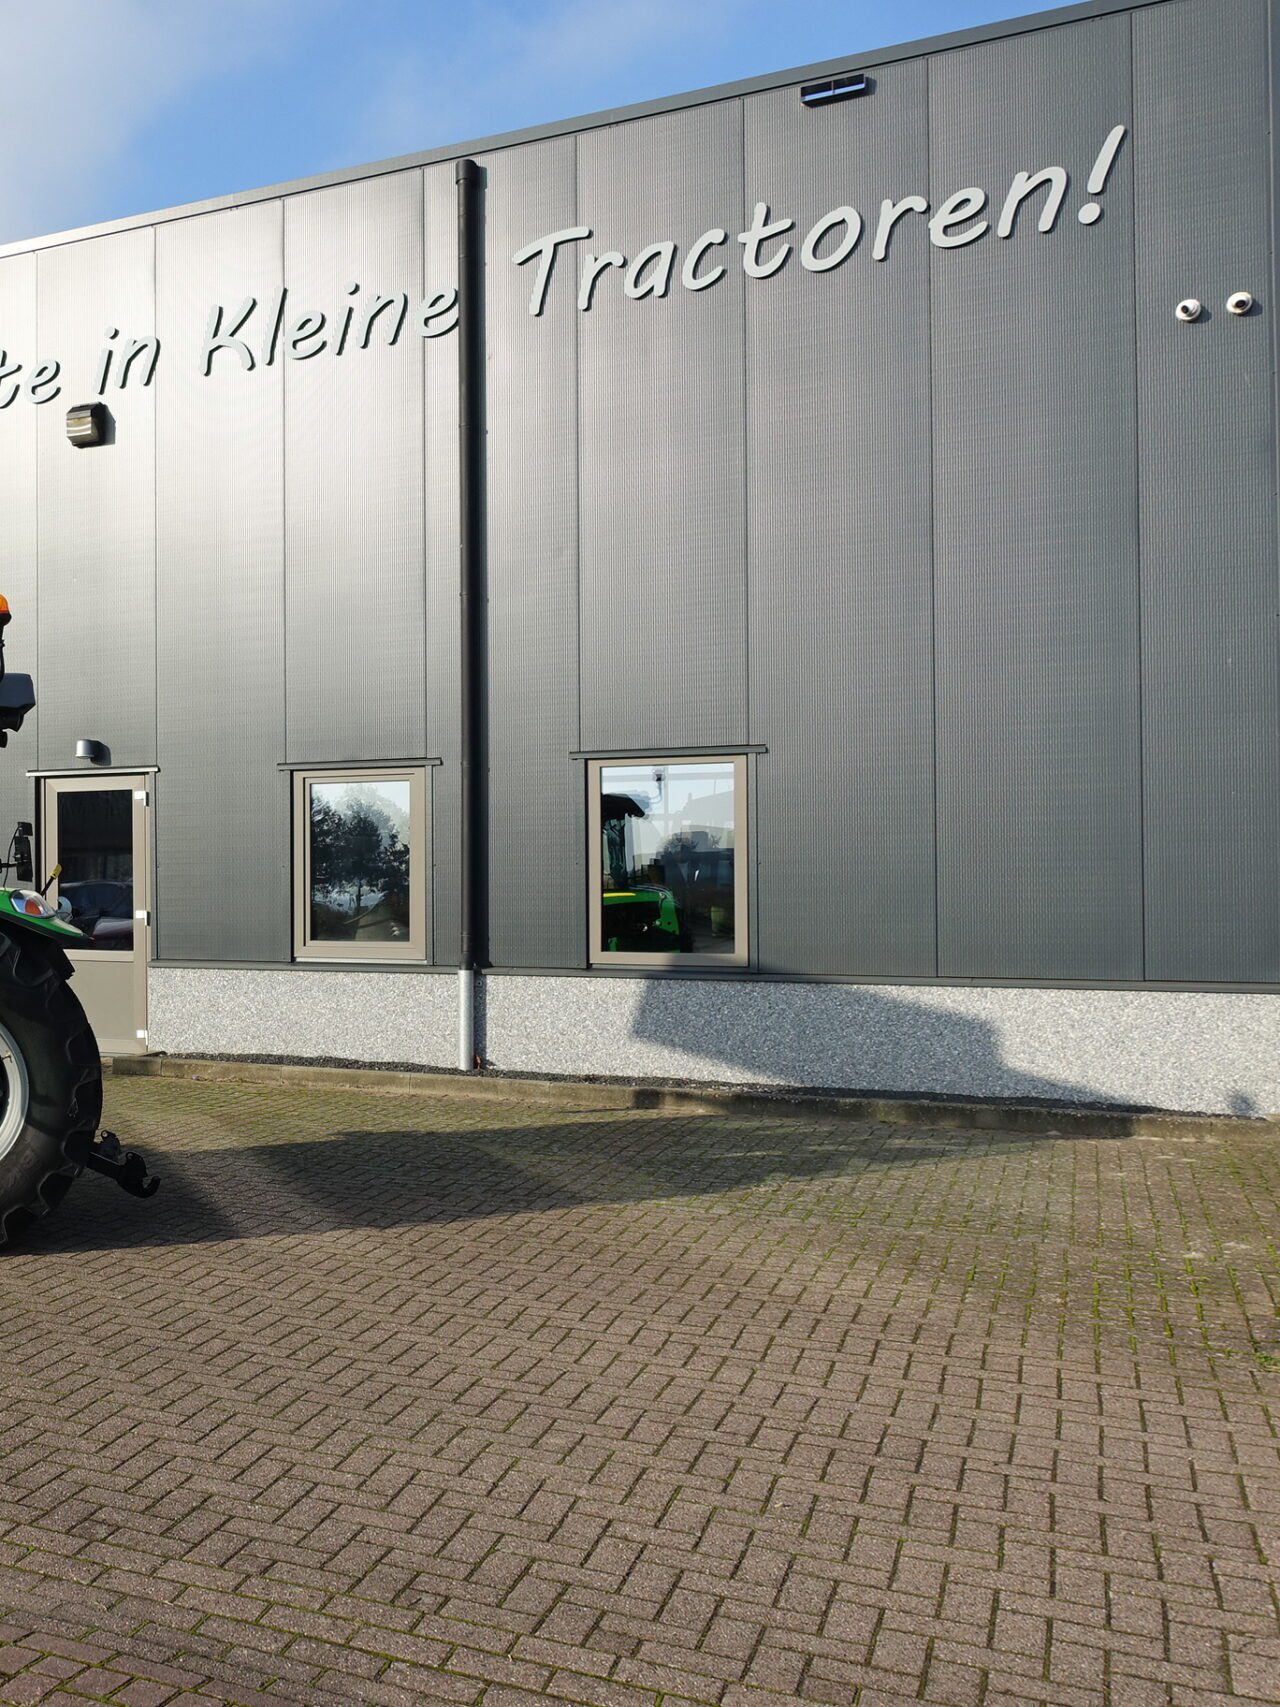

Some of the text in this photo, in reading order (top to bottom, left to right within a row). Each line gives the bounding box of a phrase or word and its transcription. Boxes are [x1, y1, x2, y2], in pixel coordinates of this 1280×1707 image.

[93, 326, 161, 395] in
[199, 281, 459, 376] Kleine
[513, 125, 1126, 317] Tractoren!
